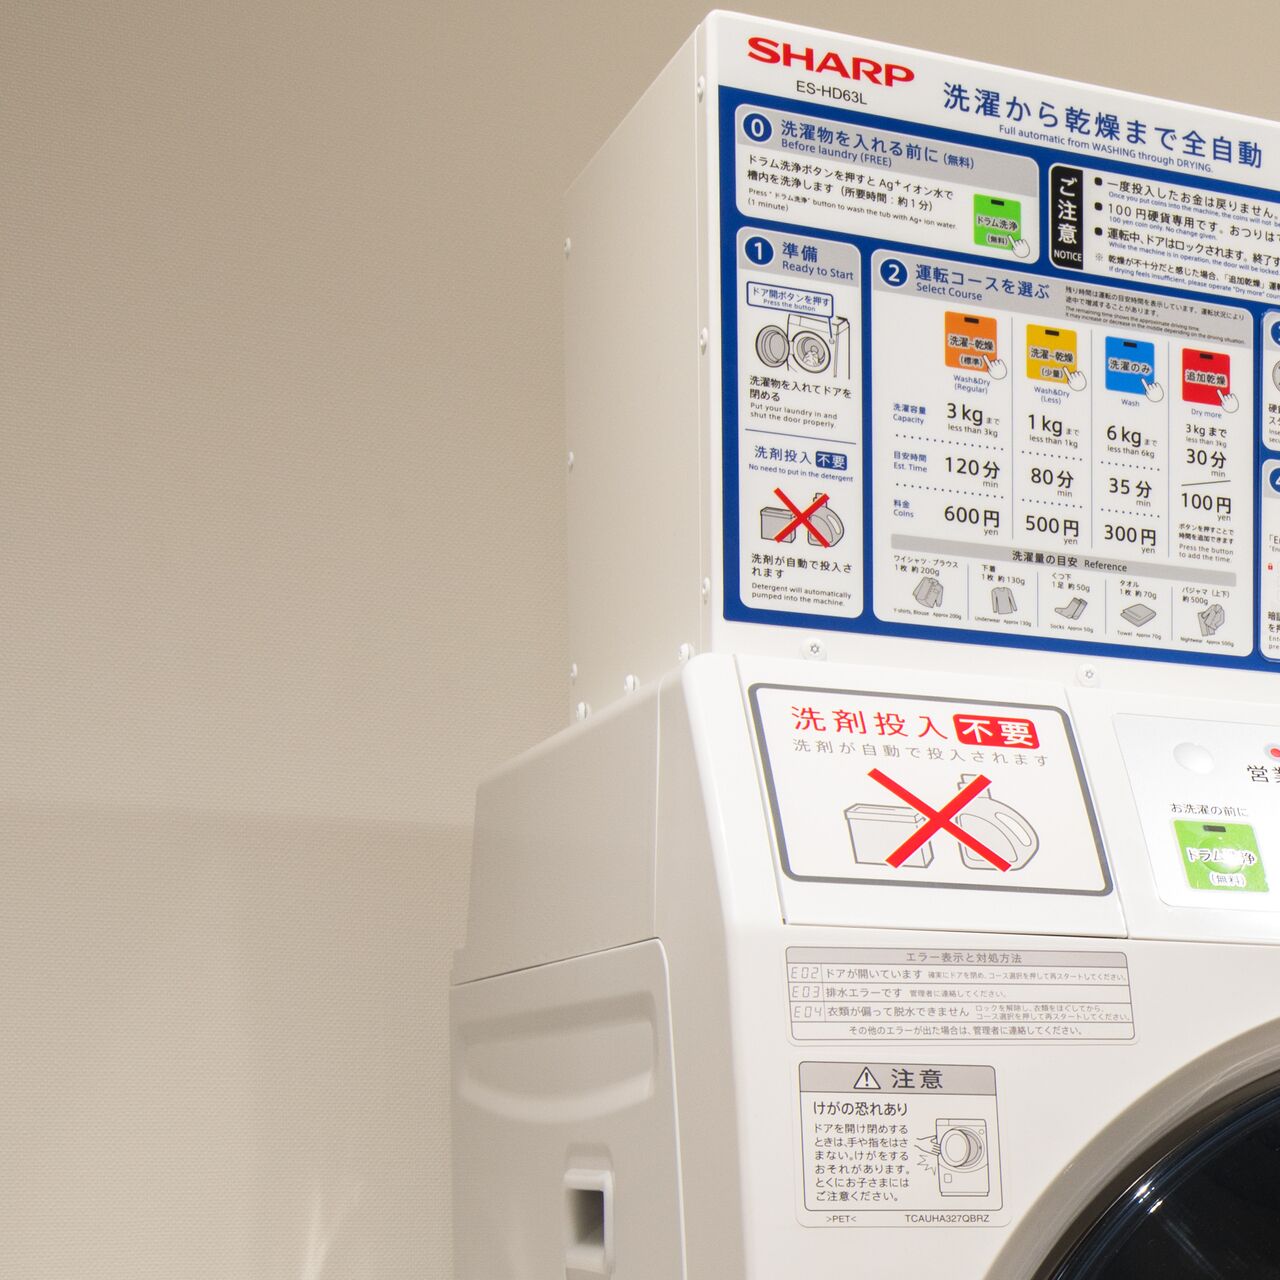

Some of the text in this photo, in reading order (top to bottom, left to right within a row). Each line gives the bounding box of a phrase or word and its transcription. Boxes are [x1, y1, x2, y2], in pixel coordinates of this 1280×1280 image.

[747, 36, 915, 88] SHARP
[796, 80, 868, 105] ES-HD63L
[751, 117, 765, 138] 0
[943, 81, 1262, 169] 洗濯から乾燥まで全自動
[781, 118, 939, 163] 洗濯物を入れる前に
[999, 124, 1016, 136] Full
[1018, 128, 1065, 146] automatic
[1067, 138, 1090, 150] from
[1092, 141, 1136, 159] WASHING
[1138, 151, 1175, 166] through
[781, 138, 892, 168] Before laundry (FREE)
[1057, 177, 1078, 244] ご注意
[754, 242, 763, 260] 1
[782, 241, 818, 263] 準備
[1053, 249, 1083, 262] NOTICE
[782, 261, 854, 280] Ready to Start
[888, 265, 900, 283] 2
[916, 263, 1050, 299] 運転コースを選ぶ
[916, 282, 983, 301] Select Course
[1110, 359, 1151, 374] 洗濯のみ
[1186, 370, 1226, 386] 追加乾燥
[954, 383, 988, 394] (Regular)
[1040, 395, 1062, 405] (Less)
[1121, 399, 1140, 408] Wash
[893, 413, 924, 425] Capacity
[1191, 408, 1205, 417] Dry
[754, 445, 847, 469] 洗剤投入 不要
[893, 509, 914, 518] Coins
[1012, 550, 1127, 573] 洗濯量の目安 Reference
[791, 706, 1034, 746] 洗剤投入 不要
[792, 738, 1049, 767] 洗剤が自動で投入されます
[906, 952, 1022, 965] エラー表示と対処方法
[825, 968, 923, 980] ドアが開いています
[825, 987, 902, 999] 排水エラーです
[891, 1068, 944, 1090] 注意
[813, 1101, 909, 1117] けがの恐れあり
[814, 1123, 909, 1135] ドアを開け閉めする
[814, 1137, 909, 1149] ときは、手や指をはさ
[815, 1164, 911, 1175] おそれがあります。
[815, 1177, 910, 1189] とくにお子さまには
[815, 1191, 899, 1203] ご注意ください。
